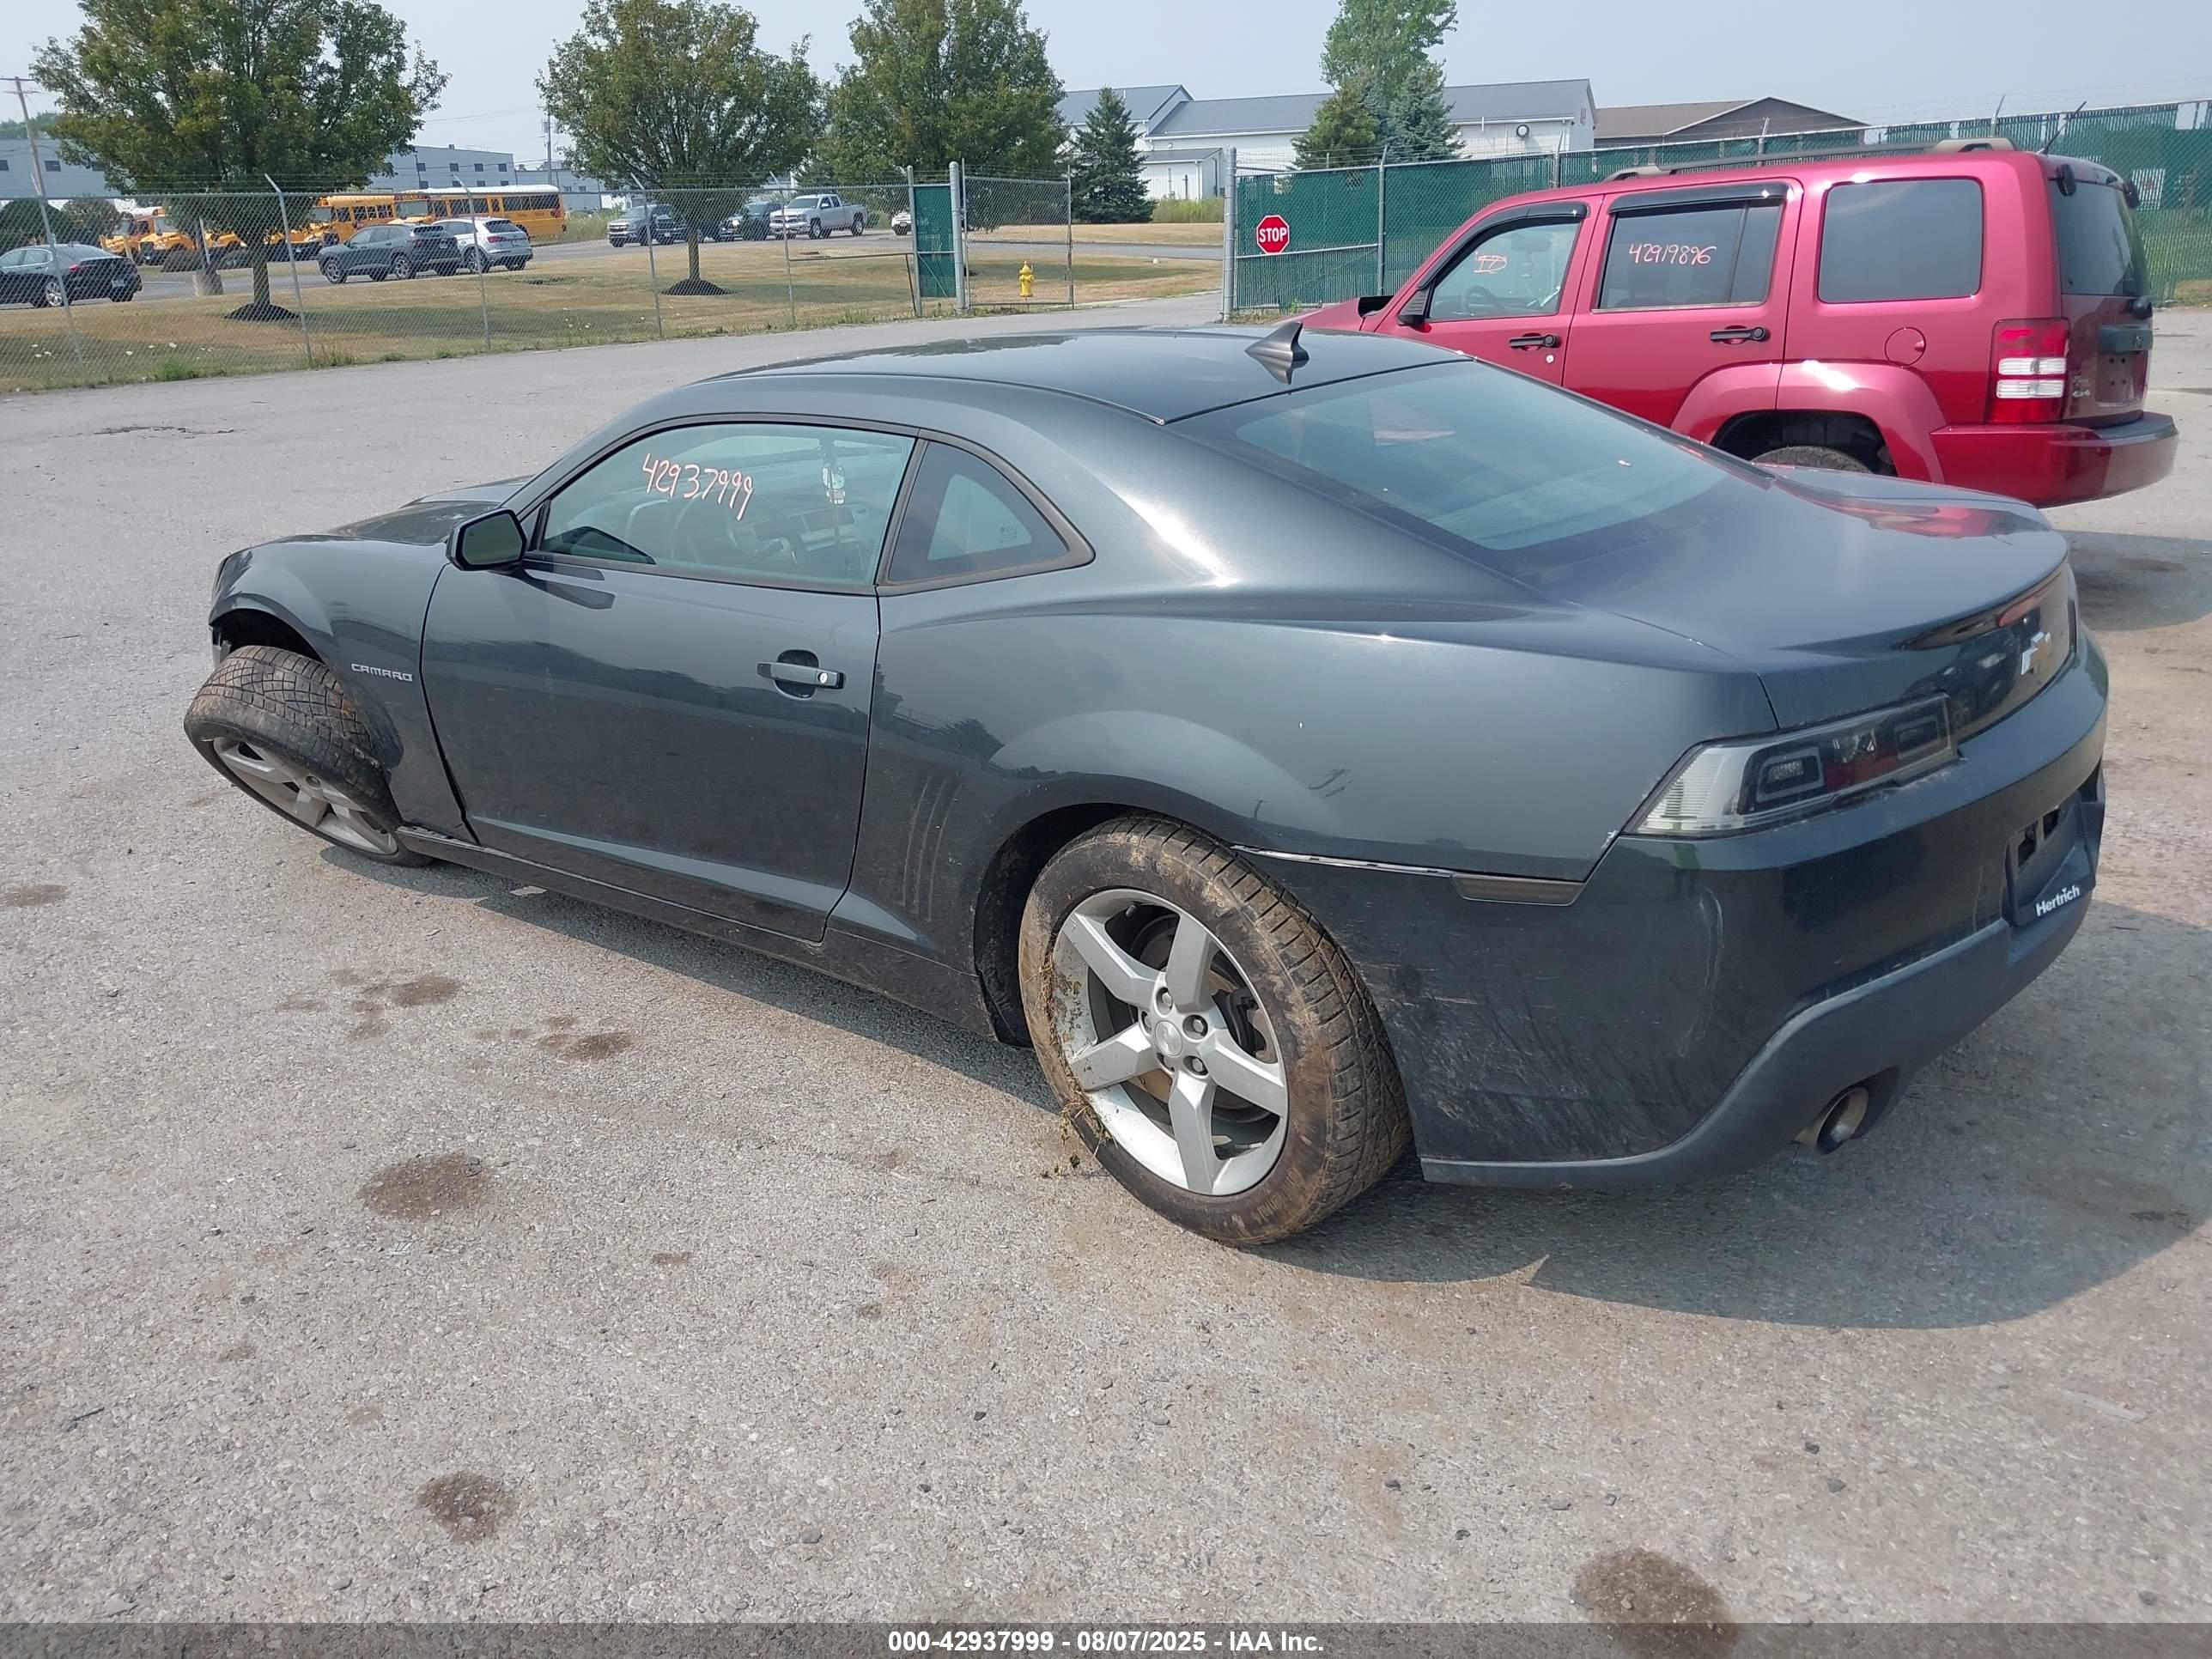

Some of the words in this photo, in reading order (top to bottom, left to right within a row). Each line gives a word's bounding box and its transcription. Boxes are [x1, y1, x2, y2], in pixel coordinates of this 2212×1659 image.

[1259, 227, 1287, 243] STOP
[1629, 243, 1717, 265] 42919896
[642, 453, 754, 521] 42937999
[351, 663, 413, 682] CAMARO
[2035, 884, 2081, 917] Hertrich
